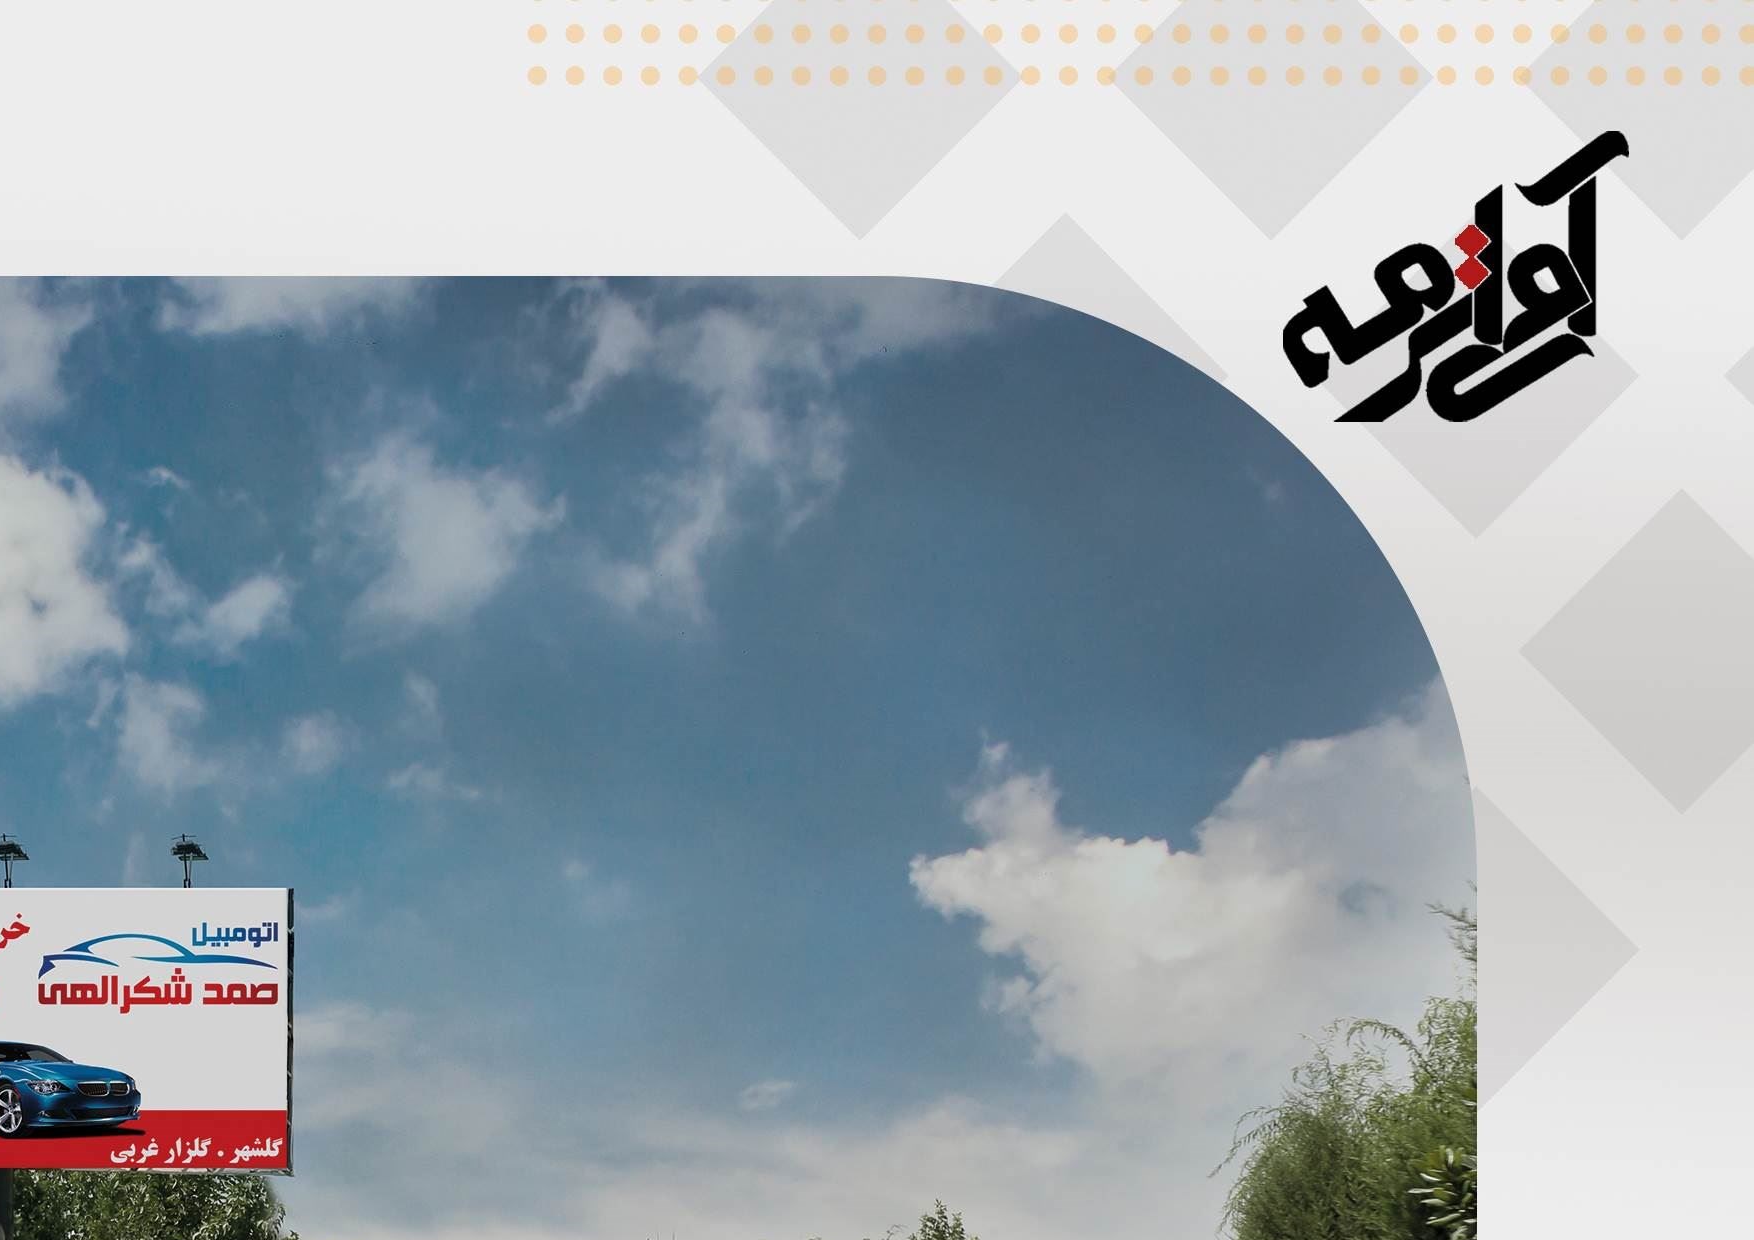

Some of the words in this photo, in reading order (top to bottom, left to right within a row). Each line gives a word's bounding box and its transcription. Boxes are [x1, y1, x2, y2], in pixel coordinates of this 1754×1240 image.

[191, 921, 279, 949] اتومبیل
[38, 967, 193, 1014] شکرالهی
[202, 983, 279, 1005] صمد
[110, 1137, 159, 1164] غربی
[164, 1137, 212, 1164] گلزار
[229, 1137, 283, 1164] گلشهر
